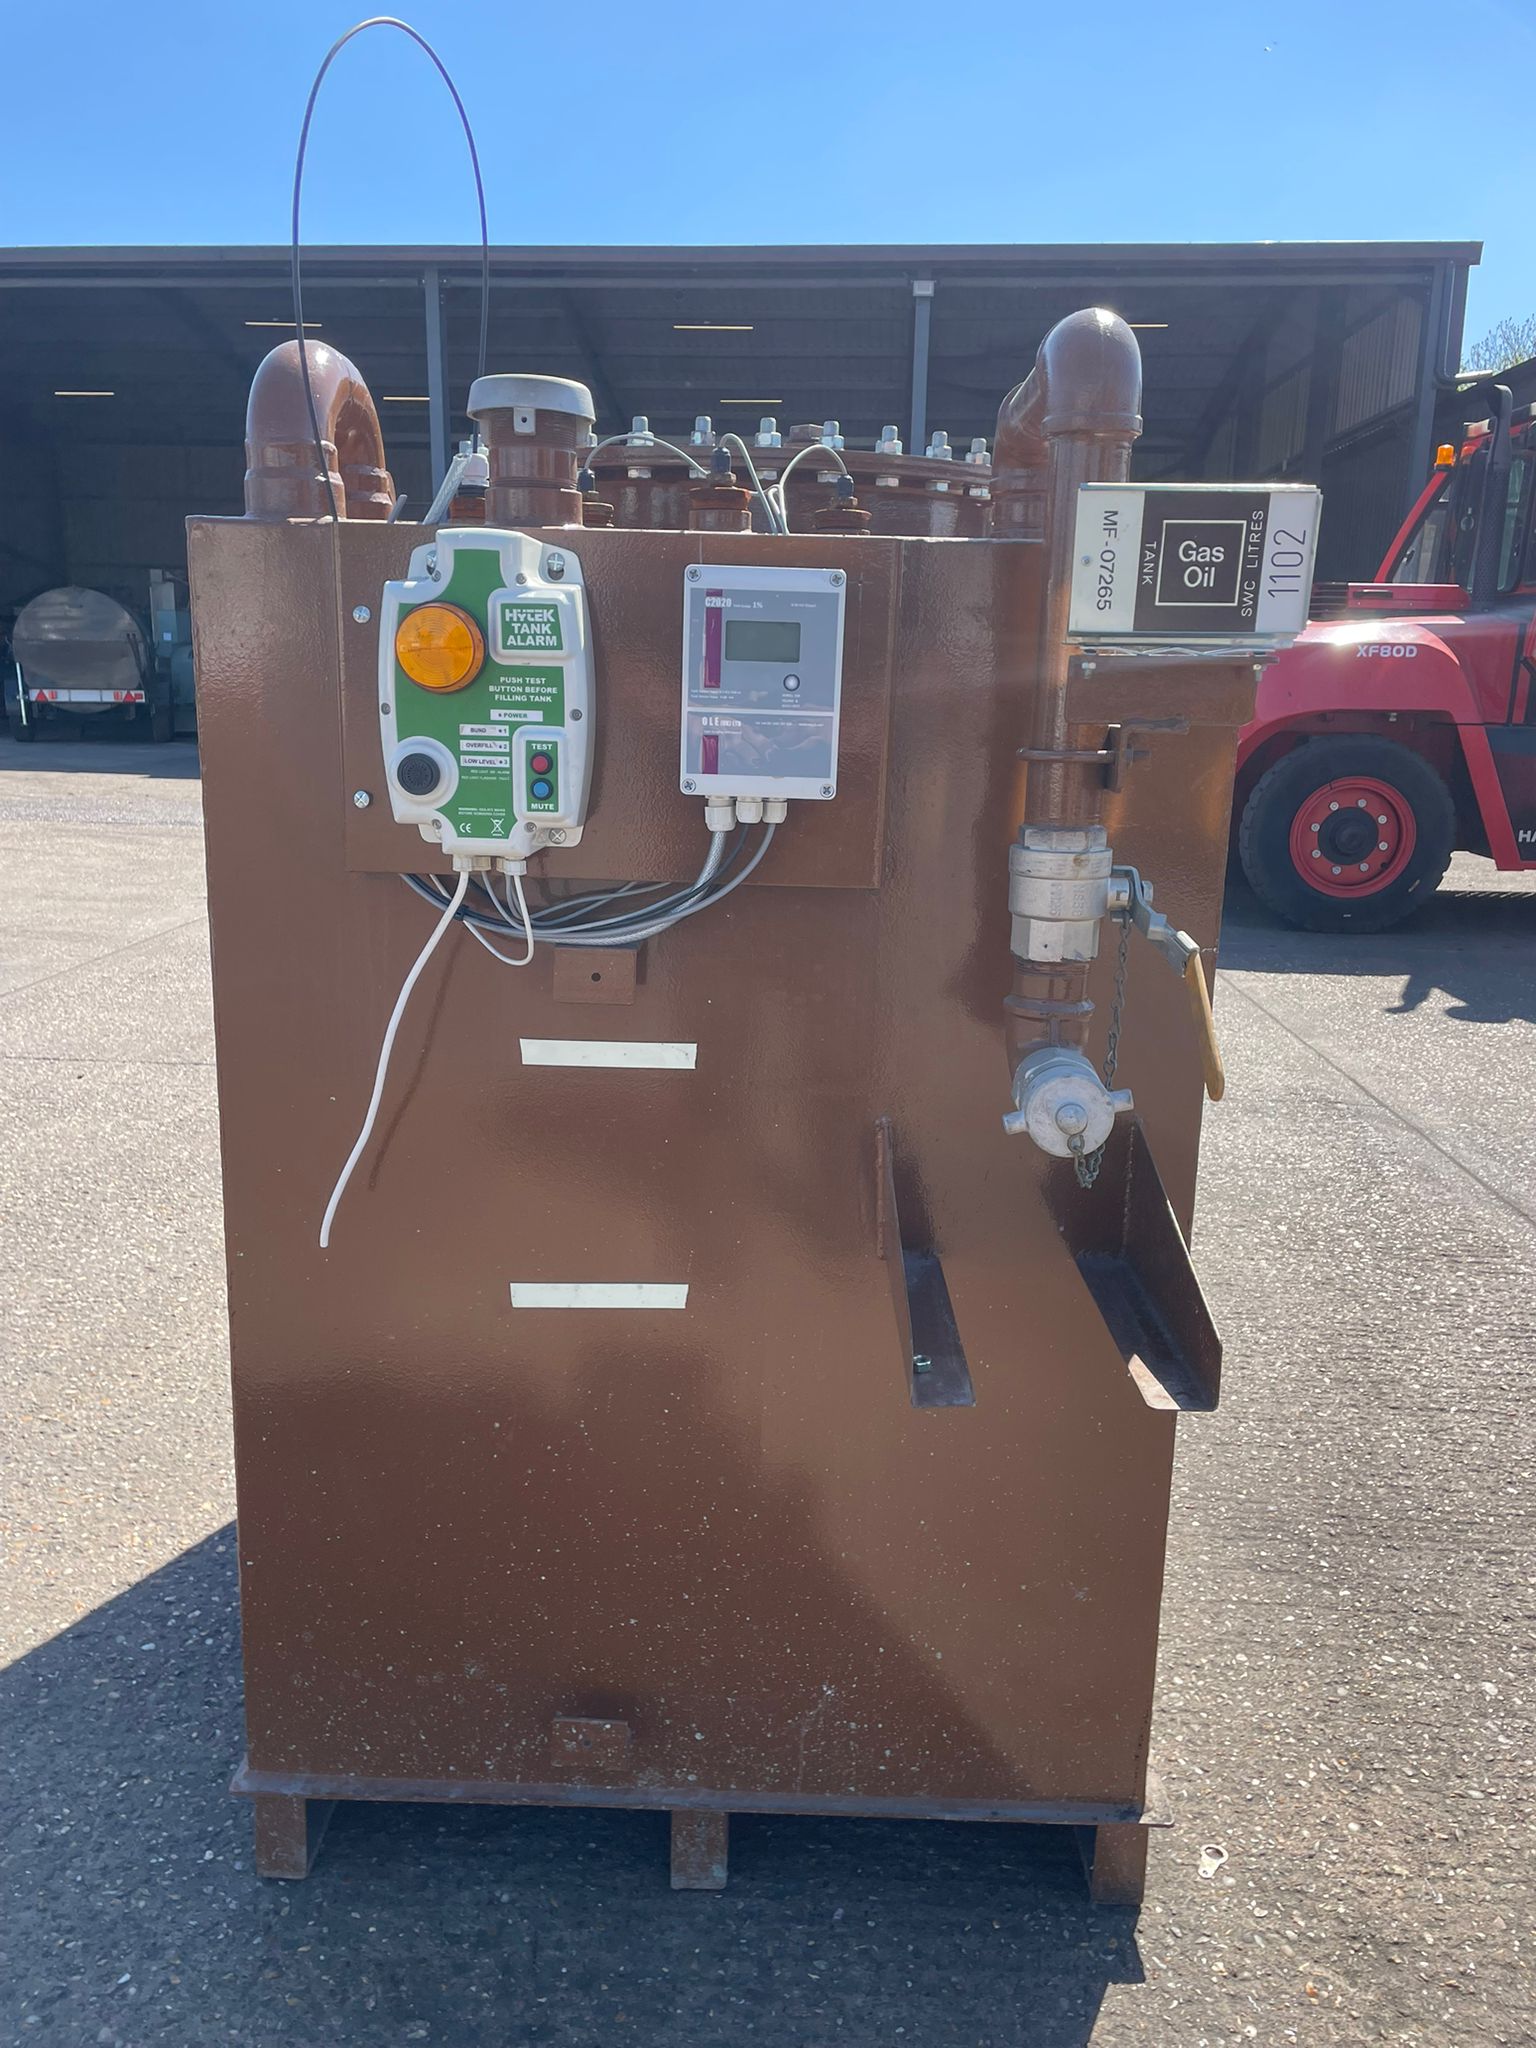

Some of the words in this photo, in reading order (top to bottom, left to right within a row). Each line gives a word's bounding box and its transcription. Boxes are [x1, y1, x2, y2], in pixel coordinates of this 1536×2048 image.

[1246, 510, 1264, 568] LITRES
[1178, 541, 1225, 563] Gas
[1097, 510, 1118, 611] MF-07265
[1141, 541, 1157, 585] TANK
[1267, 529, 1306, 598] 1102
[1184, 566, 1215, 587] Oil
[705, 596, 732, 607] C2020
[1241, 580, 1256, 617] SWC
[512, 623, 552, 634] TANK
[507, 635, 557, 646] ALARM
[1356, 645, 1417, 657] XF80D
[500, 676, 523, 684] PUSH
[525, 677, 546, 685] TEST
[489, 685, 523, 693] BUTTON
[525, 686, 558, 694] BEFORE
[495, 694, 528, 702] FILLING
